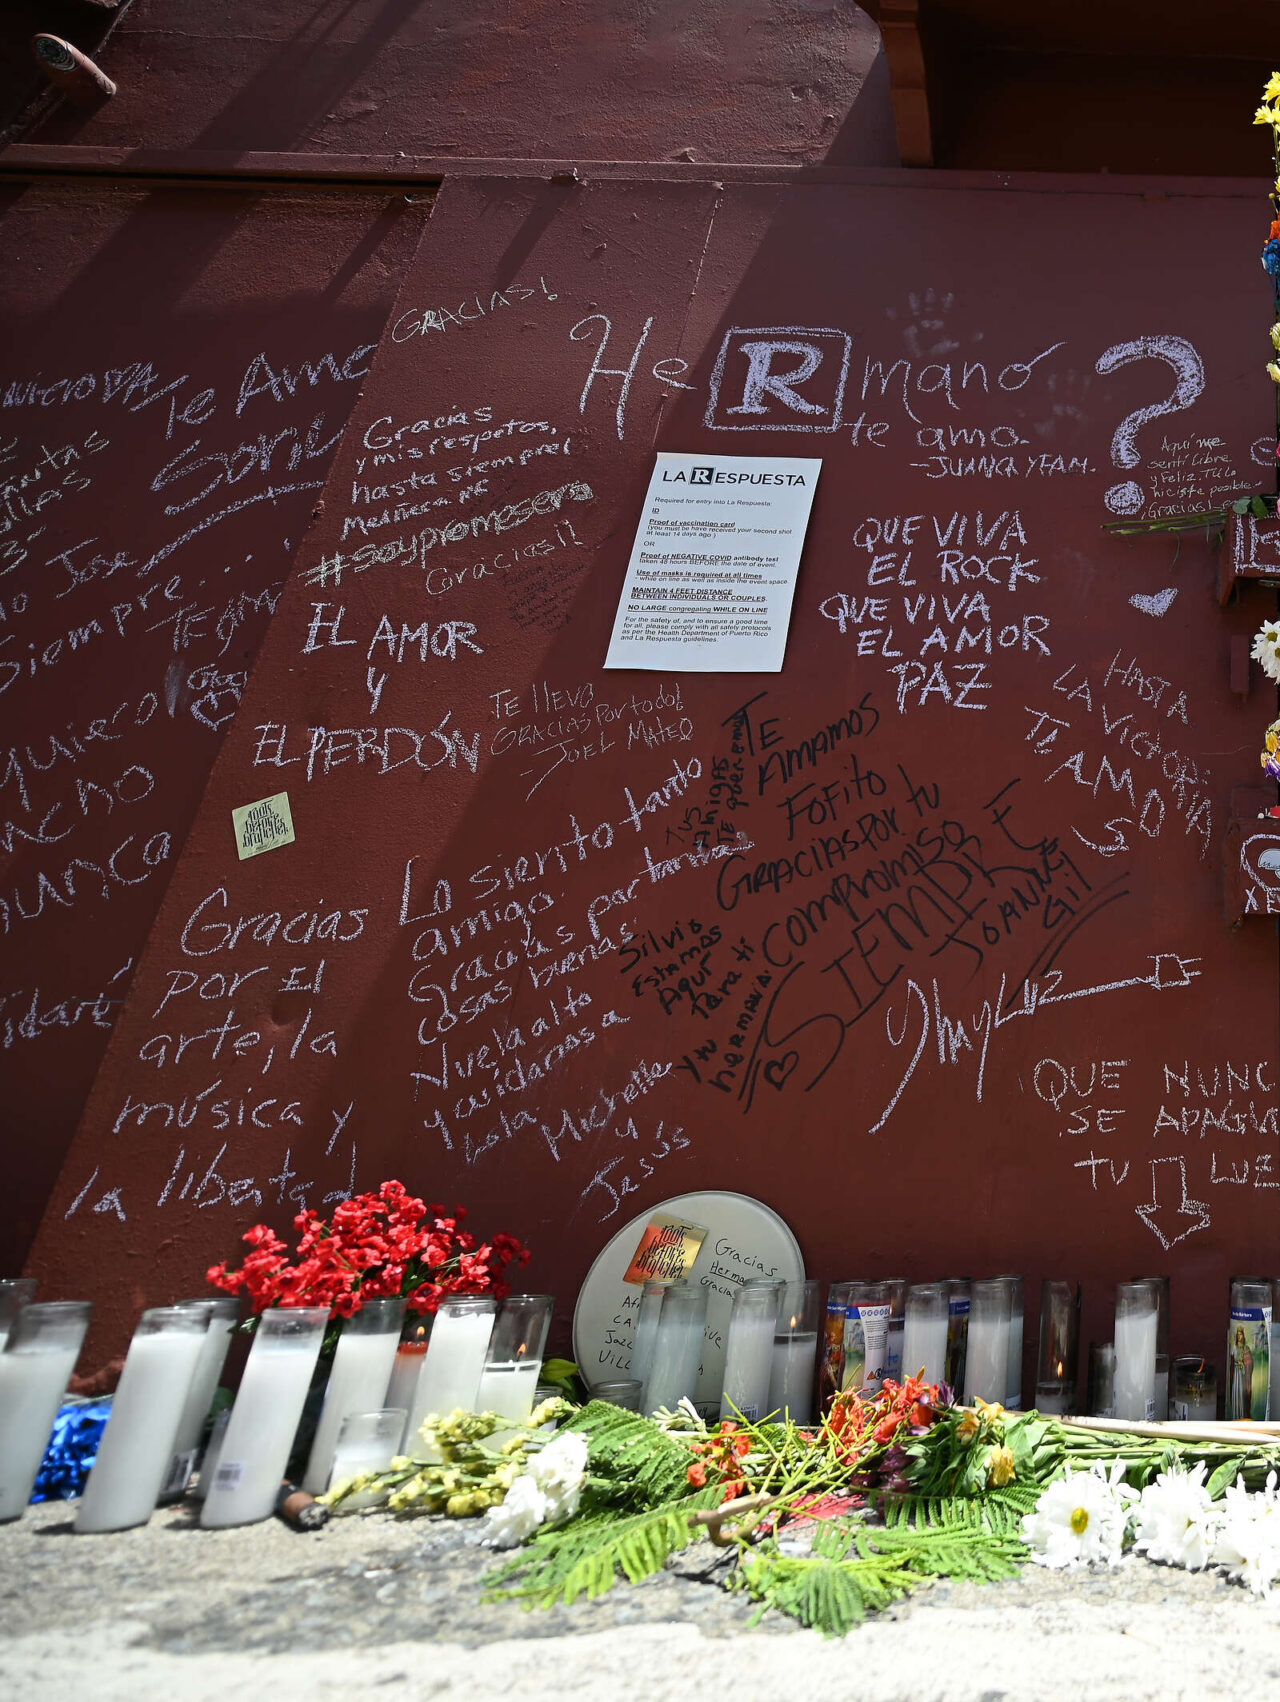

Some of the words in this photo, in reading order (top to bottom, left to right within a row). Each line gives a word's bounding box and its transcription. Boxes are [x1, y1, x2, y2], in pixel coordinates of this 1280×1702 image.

[364, 406, 492, 449] Gracias
[843, 413, 891, 448] te
[374, 444, 423, 466] mis
[662, 470, 687, 483] LA
[688, 466, 806, 486] RESPUESTA
[352, 472, 437, 504] hasta
[853, 514, 926, 553] QUE
[933, 510, 1029, 551] VIVA
[867, 553, 917, 588] EL
[938, 549, 1043, 592] ROCK
[818, 593, 888, 633] QUE
[903, 591, 991, 624] VIVA
[367, 614, 484, 664] AMOR
[857, 629, 904, 658] EL
[920, 613, 1052, 658] AMOR
[489, 690, 522, 718] TE
[888, 660, 992, 714] PAZ
[1053, 664, 1092, 712] LA
[307, 711, 480, 781] PERDÓN
[400, 856, 452, 925] Lo
[469, 814, 615, 899] siento
[620, 756, 701, 832] tanto
[181, 887, 370, 957] Gracias
[408, 924, 575, 1002] Gracias
[588, 880, 640, 941] por
[418, 980, 514, 1045] cosas
[532, 988, 593, 1031] alto
[289, 1009, 338, 1060] la
[1033, 1058, 1131, 1111] QUE
[112, 1080, 303, 1134] música
[326, 1101, 354, 1156] y
[1067, 1105, 1126, 1137] SE
[1074, 1151, 1130, 1190] TU
[1210, 1152, 1280, 1190] LUZ
[65, 1166, 126, 1222] la
[710, 1261, 746, 1285] Herma
[715, 1238, 778, 1277] Gracias
[700, 1276, 735, 1299] Gracia
